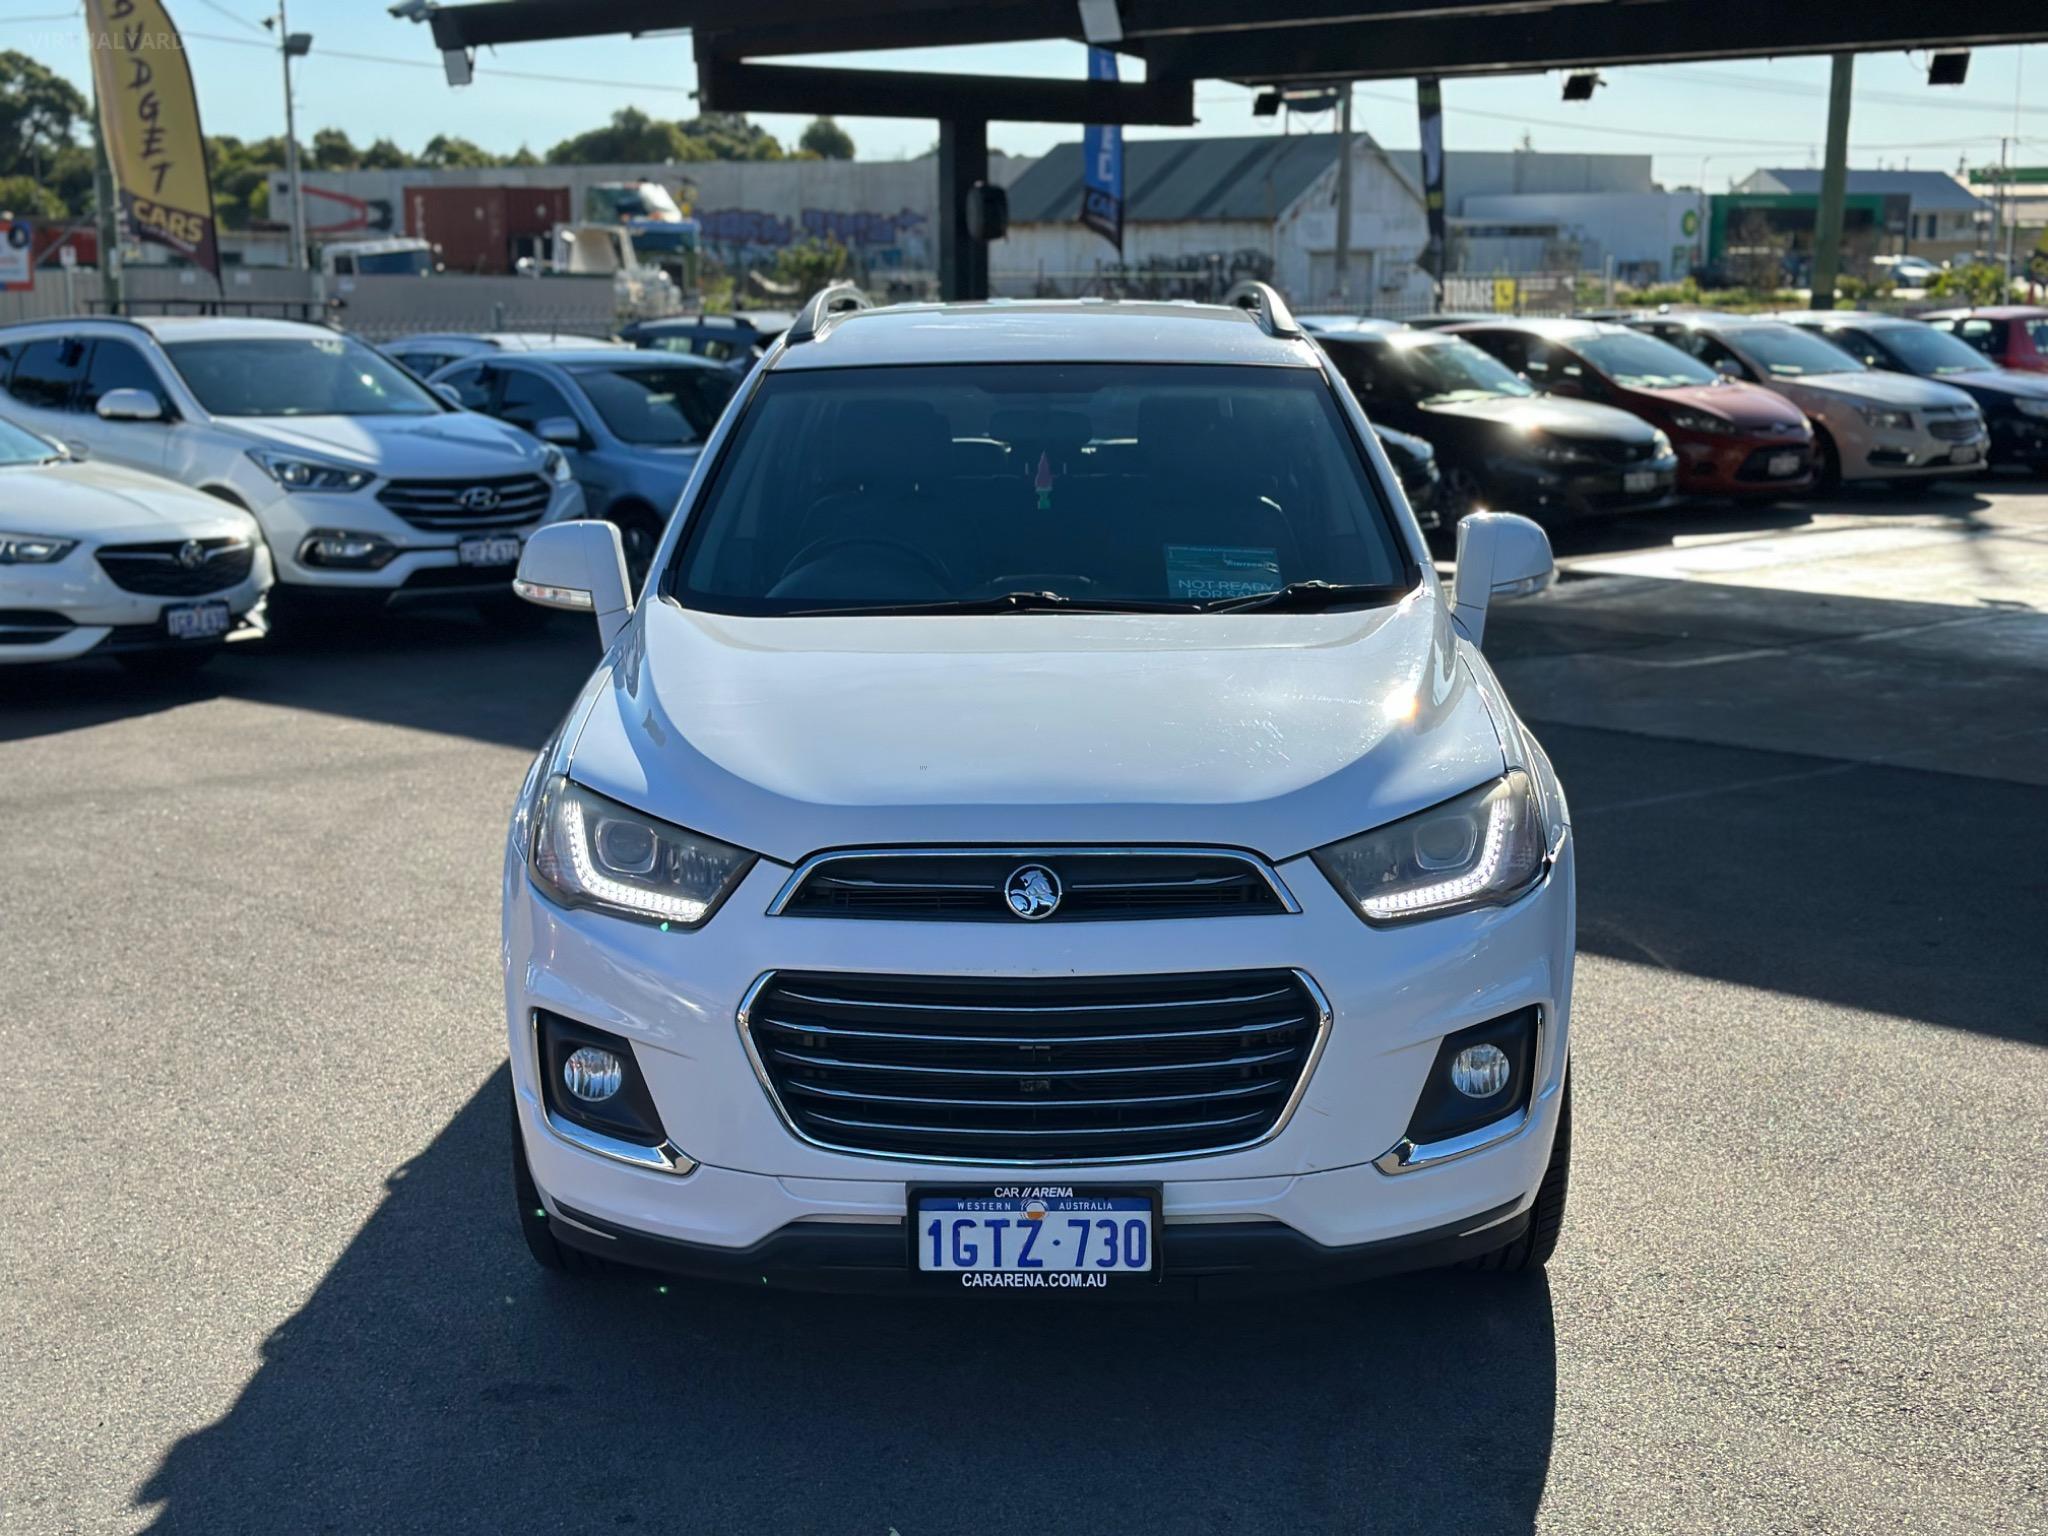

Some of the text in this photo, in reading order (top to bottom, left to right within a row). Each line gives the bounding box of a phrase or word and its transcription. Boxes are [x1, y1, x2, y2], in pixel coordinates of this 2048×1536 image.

[108, 0, 173, 195] BUDGET
[132, 199, 204, 243] CARS
[1178, 579, 1274, 592] NOT READY
[1188, 589, 1222, 598] FOR
[994, 1187, 1019, 1198] CAR
[957, 1201, 1113, 1211] WESTERN AUSTRALIA
[961, 1273, 1107, 1288] CARARENA.COM.AU
